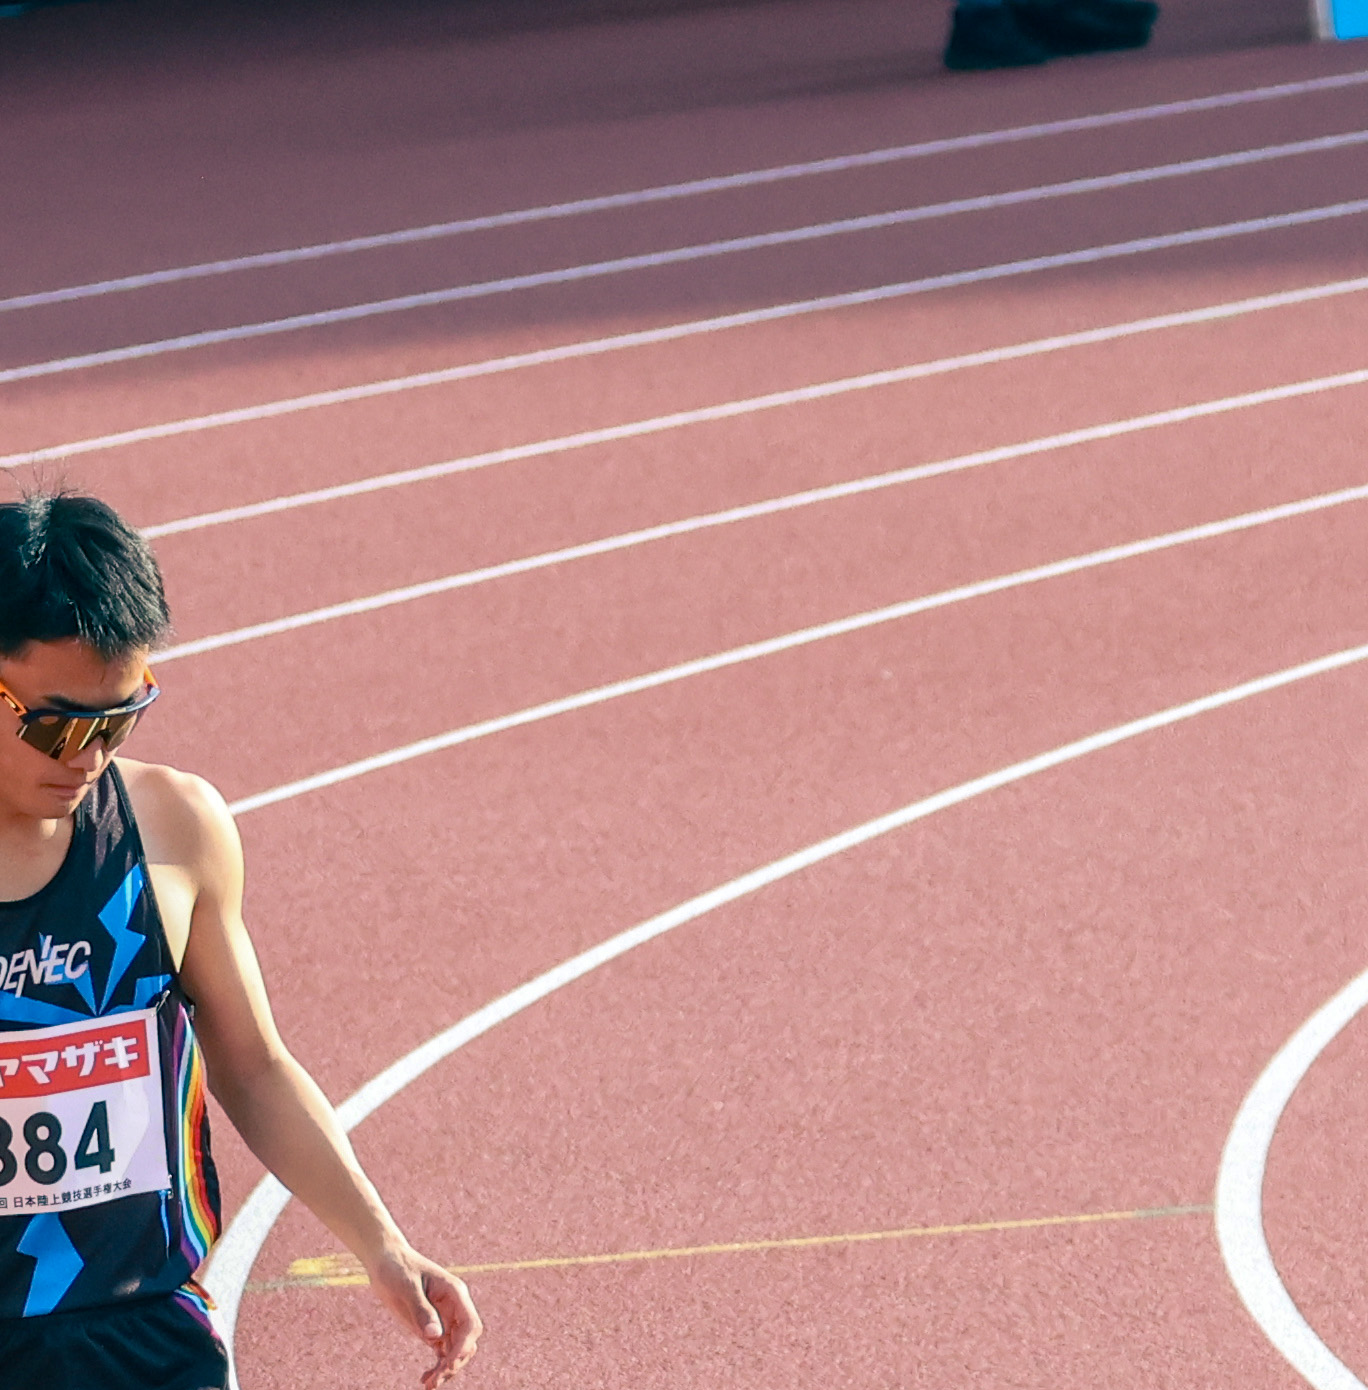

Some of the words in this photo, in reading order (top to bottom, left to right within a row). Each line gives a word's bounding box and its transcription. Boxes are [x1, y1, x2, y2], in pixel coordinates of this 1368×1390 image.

[12, 1178, 133, 1209] 日本陸上競技選手権大会
